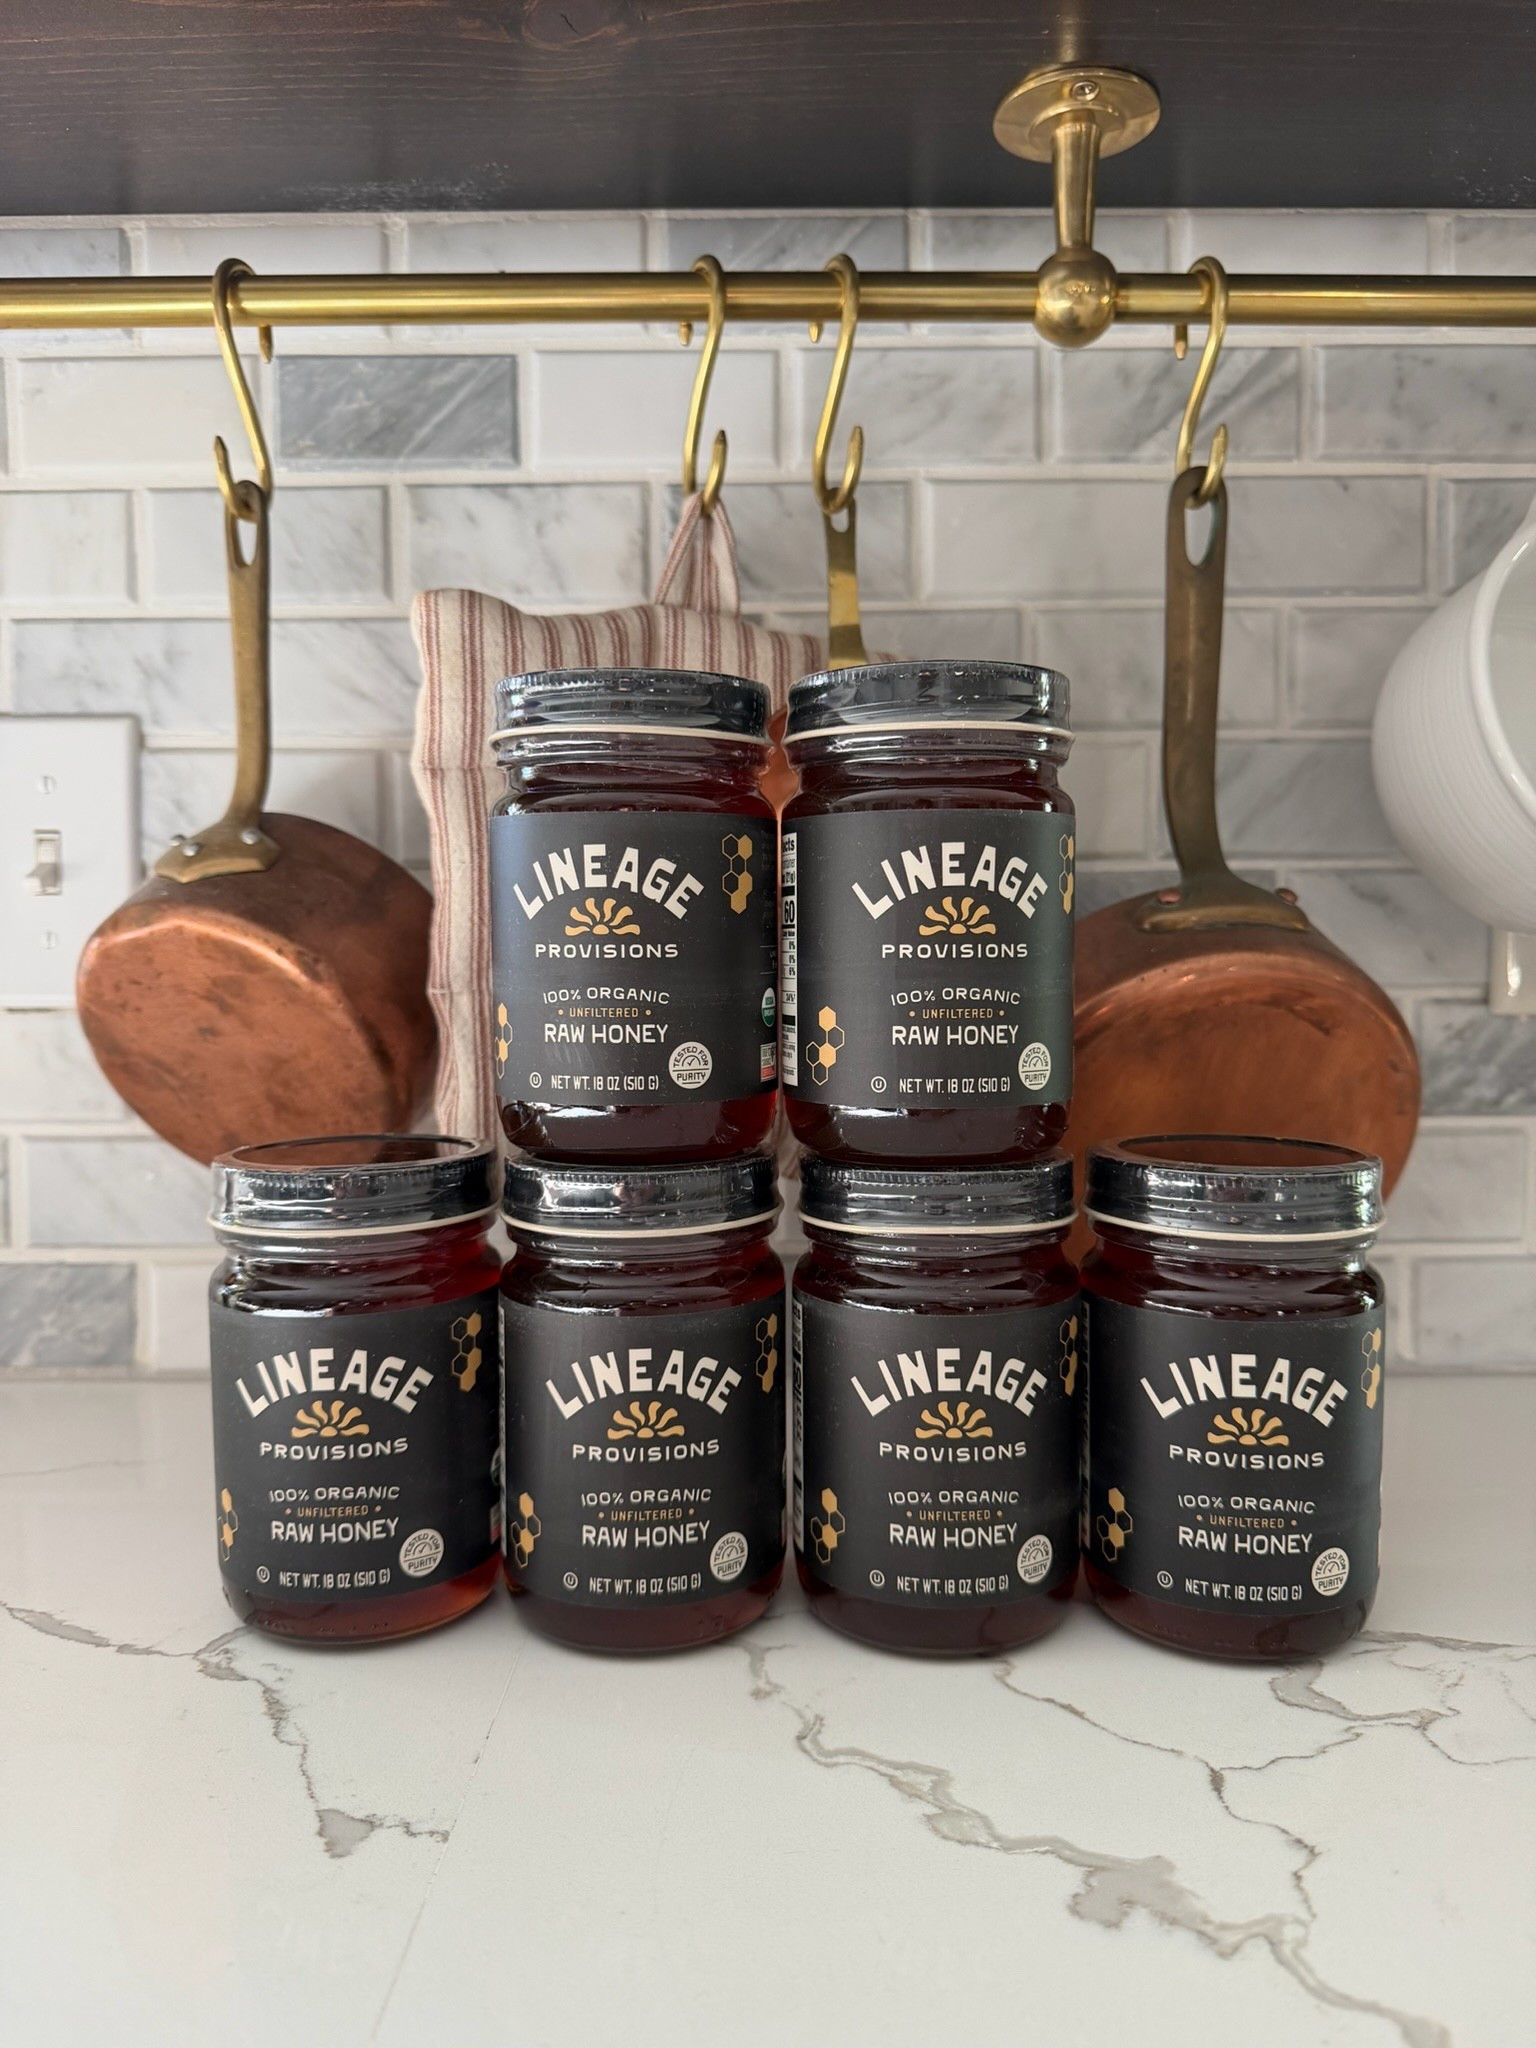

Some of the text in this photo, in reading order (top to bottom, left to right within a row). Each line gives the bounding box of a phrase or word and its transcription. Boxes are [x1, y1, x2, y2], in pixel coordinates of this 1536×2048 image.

[513, 844, 705, 920] LINEAGE
[851, 842, 1048, 920] LINEAGE
[784, 900, 795, 923] 60
[535, 944, 678, 958] PROVISIONS
[882, 944, 1027, 958] PROVISIONS
[543, 987, 669, 1004] 100% ORGANIC
[891, 988, 1020, 1006] 100% ORGANIC
[569, 1008, 638, 1017] UNFILTERED
[923, 1009, 992, 1018] UNFILTERED
[545, 1024, 667, 1043] RAW HONEY
[893, 1025, 1018, 1045] RAW HONEY
[673, 1046, 708, 1068] TESTED FOR
[1022, 1047, 1041, 1069] TESTED
[552, 1075, 658, 1090] NET WT. 18 OZ (510 G)
[677, 1072, 706, 1081] PURITY
[900, 1077, 1010, 1093] NET WT. 18 OZ (510 G)
[1025, 1073, 1047, 1082] PURITY
[236, 1348, 435, 1418] LINEAGE
[546, 1348, 743, 1420] LINEAGE
[851, 1348, 1047, 1418] LINEAGE
[1140, 1354, 1348, 1427] LINEAGE
[260, 1438, 407, 1460] PROVISIONS
[573, 1440, 719, 1462] PROVISIONS
[880, 1442, 1026, 1462] PROVISIONS
[1170, 1445, 1324, 1469] PROVISIONS
[270, 1487, 399, 1502] 100% ORGANIC
[582, 1489, 711, 1506] 100% ORGANIC
[889, 1491, 1018, 1504] 100% ORGANIC
[1178, 1495, 1315, 1513] 100% ORGANIC
[297, 1505, 368, 1517] UNFILTERED
[611, 1508, 682, 1521] UNFILTERED
[920, 1510, 990, 1521] UNFILTERED
[272, 1517, 398, 1543] RAW HONEY
[1210, 1515, 1284, 1528] UNFILTERED
[583, 1520, 709, 1547] RAW HONEY
[890, 1523, 1016, 1547] RAW HONEY
[1179, 1526, 1312, 1554] RAW HONEY
[404, 1533, 440, 1558] TESTED FOR
[714, 1536, 745, 1562] TESTED FOR
[1021, 1539, 1049, 1565] TESTED FOR
[408, 1556, 437, 1570] PURITY
[717, 1559, 742, 1575] PURITY
[1024, 1562, 1047, 1577] PURITY
[1315, 1552, 1346, 1576] TESTED FOR
[280, 1568, 390, 1588] NET WT. 18 OZ (510 G)
[590, 1573, 701, 1594] NET WT. 18 OZ (510 G)
[897, 1575, 1008, 1594] NET WT. 18 OZ (510 G)
[1318, 1576, 1343, 1589] PURITY
[1186, 1579, 1302, 1601] NET WT. 18 OZ (510 G)
